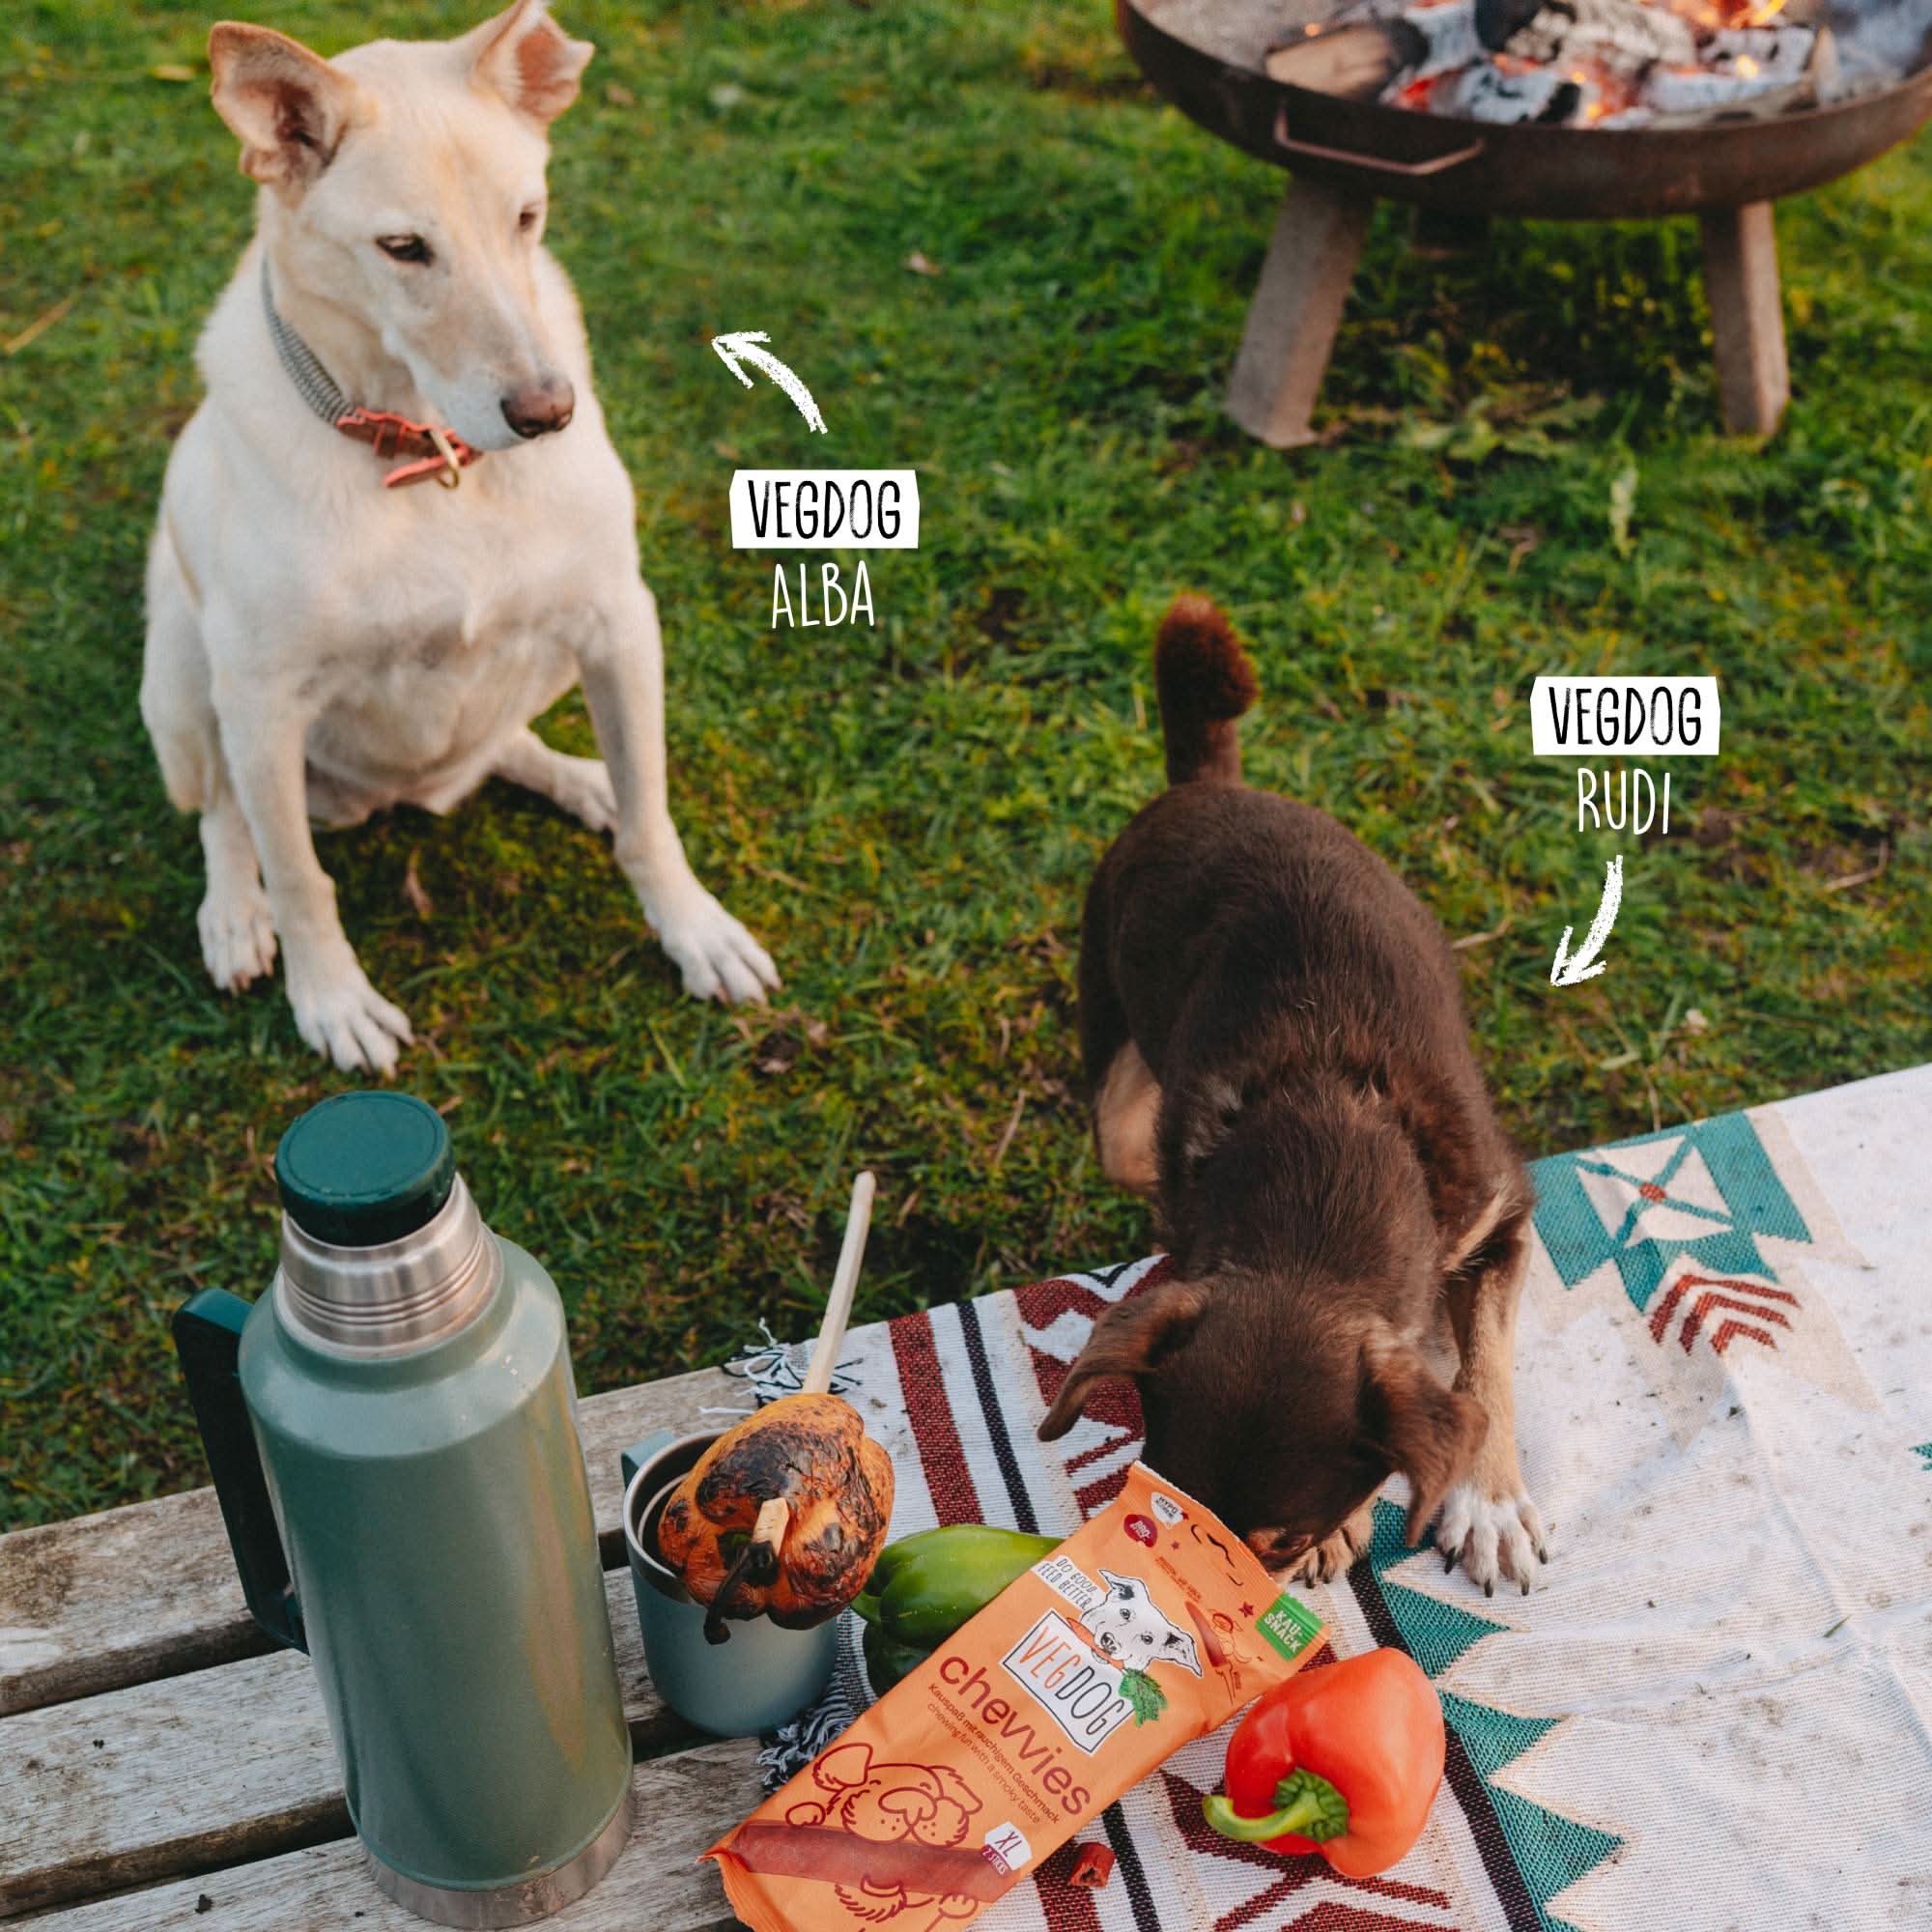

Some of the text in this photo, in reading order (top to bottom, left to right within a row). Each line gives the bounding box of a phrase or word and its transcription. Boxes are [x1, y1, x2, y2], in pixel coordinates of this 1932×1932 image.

[1037, 1563, 1063, 1582] FEED
[1056, 1558, 1073, 1573] DO
[1264, 1613, 1301, 1654] SNACK
[1019, 1626, 1125, 1736] VEGDOG
[927, 1702, 961, 1739] chewing
[956, 1733, 972, 1748] fun
[971, 1743, 990, 1767] with
[992, 1770, 1021, 1802] smoky
[1017, 1798, 1041, 1824] taste
[928, 1683, 1060, 1824] Kauspaß mit rauchigem Geschmack
[994, 1831, 1022, 1857] XL
